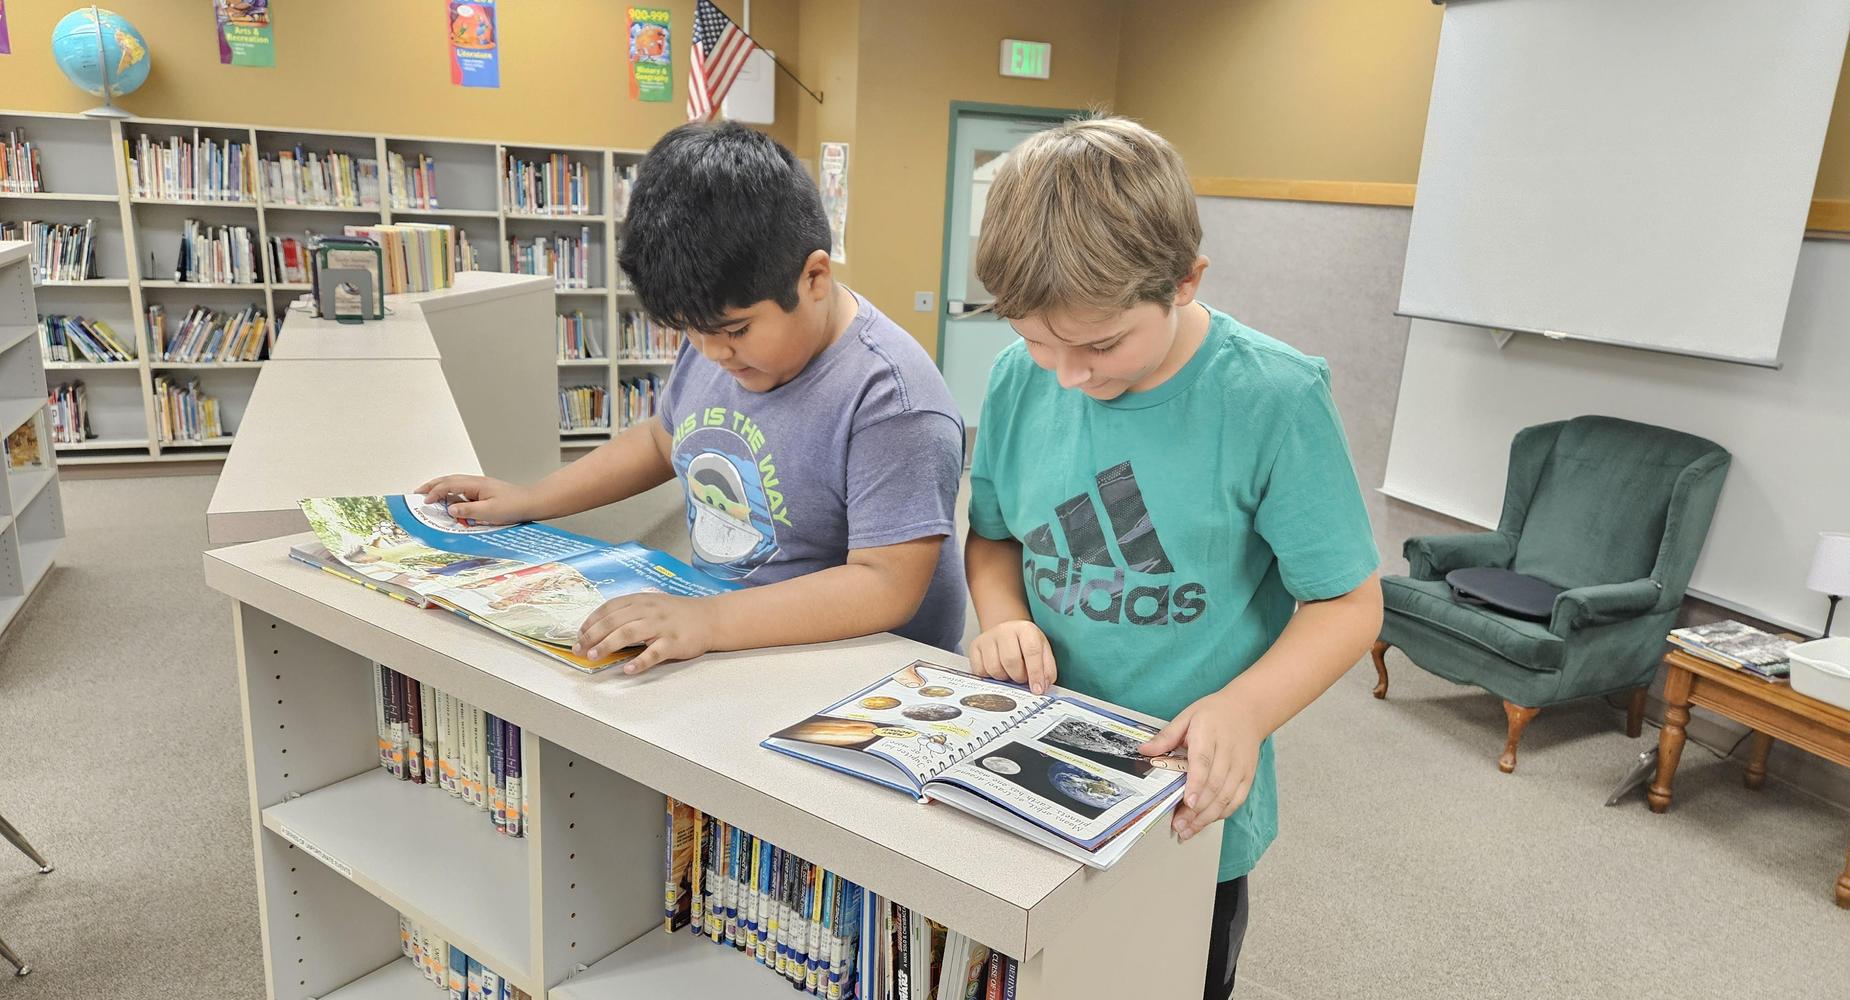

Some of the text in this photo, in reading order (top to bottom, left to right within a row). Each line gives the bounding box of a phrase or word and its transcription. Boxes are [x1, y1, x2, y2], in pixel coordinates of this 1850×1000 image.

[226, 32, 270, 44] Recreation
[234, 26, 251, 35] Arts
[1011, 42, 1046, 75] EXIT
[672, 407, 793, 528] HIS IS THE WAY
[1024, 557, 1207, 626] adidas
[991, 953, 999, 979] CURSE
[990, 979, 997, 991] OF
[1007, 964, 1016, 998] BEHIND
